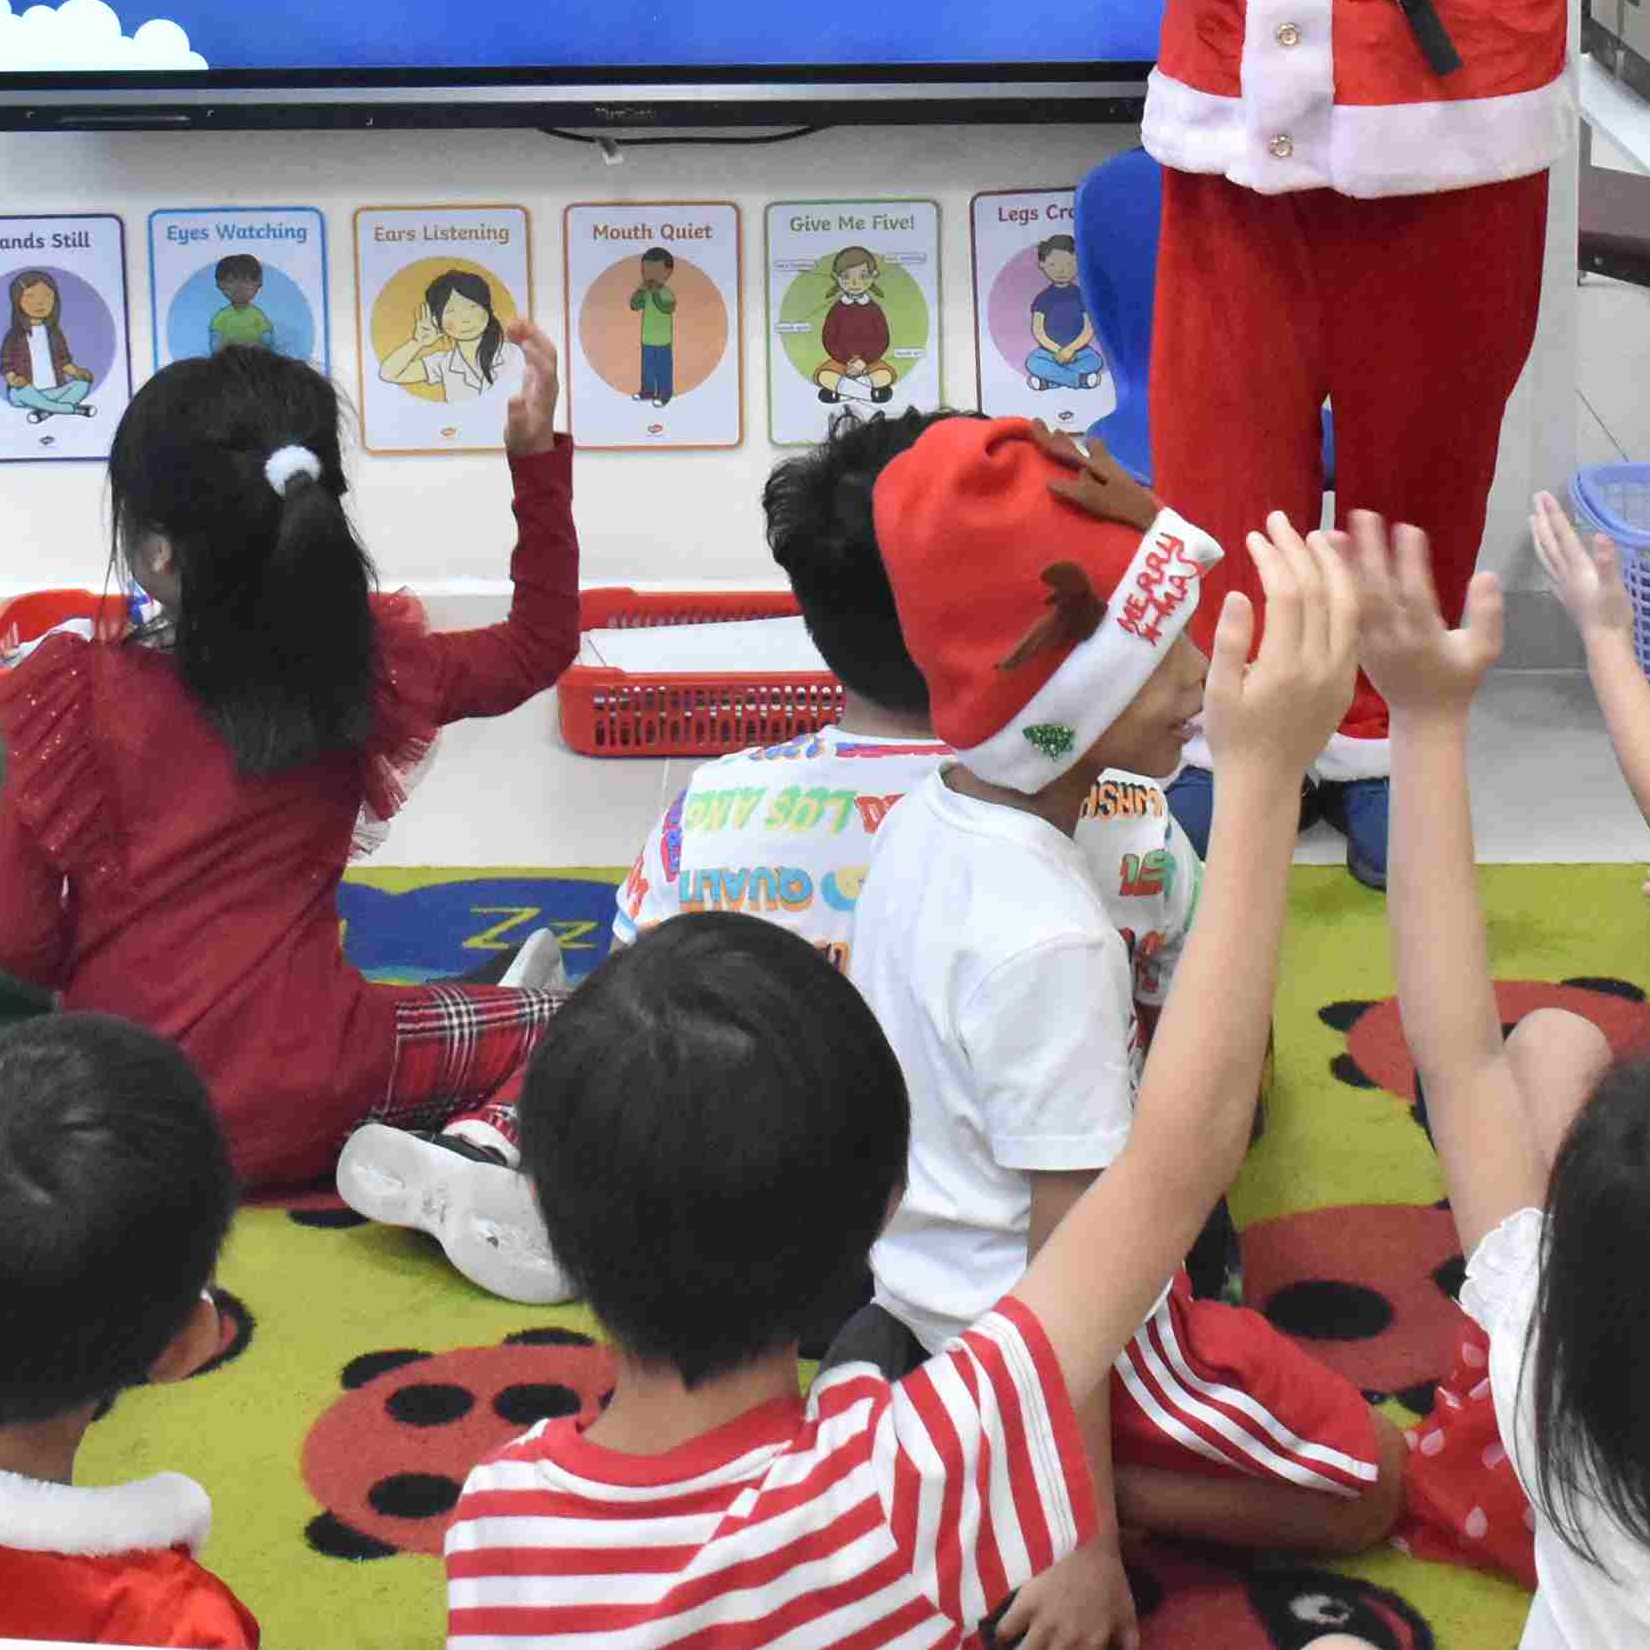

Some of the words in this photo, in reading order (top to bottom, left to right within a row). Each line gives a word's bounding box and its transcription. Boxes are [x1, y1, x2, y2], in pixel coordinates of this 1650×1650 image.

[789, 215, 833, 233] Give
[838, 215, 866, 231] Me
[871, 214, 915, 231] Five!
[997, 206, 1039, 226] Legs
[50, 231, 91, 249] Still
[166, 225, 210, 245] Eyes
[216, 223, 308, 244] Watching
[374, 226, 416, 242] Ears
[422, 224, 511, 245] Listening
[591, 223, 652, 241] Mouth
[659, 223, 713, 242] Quiet
